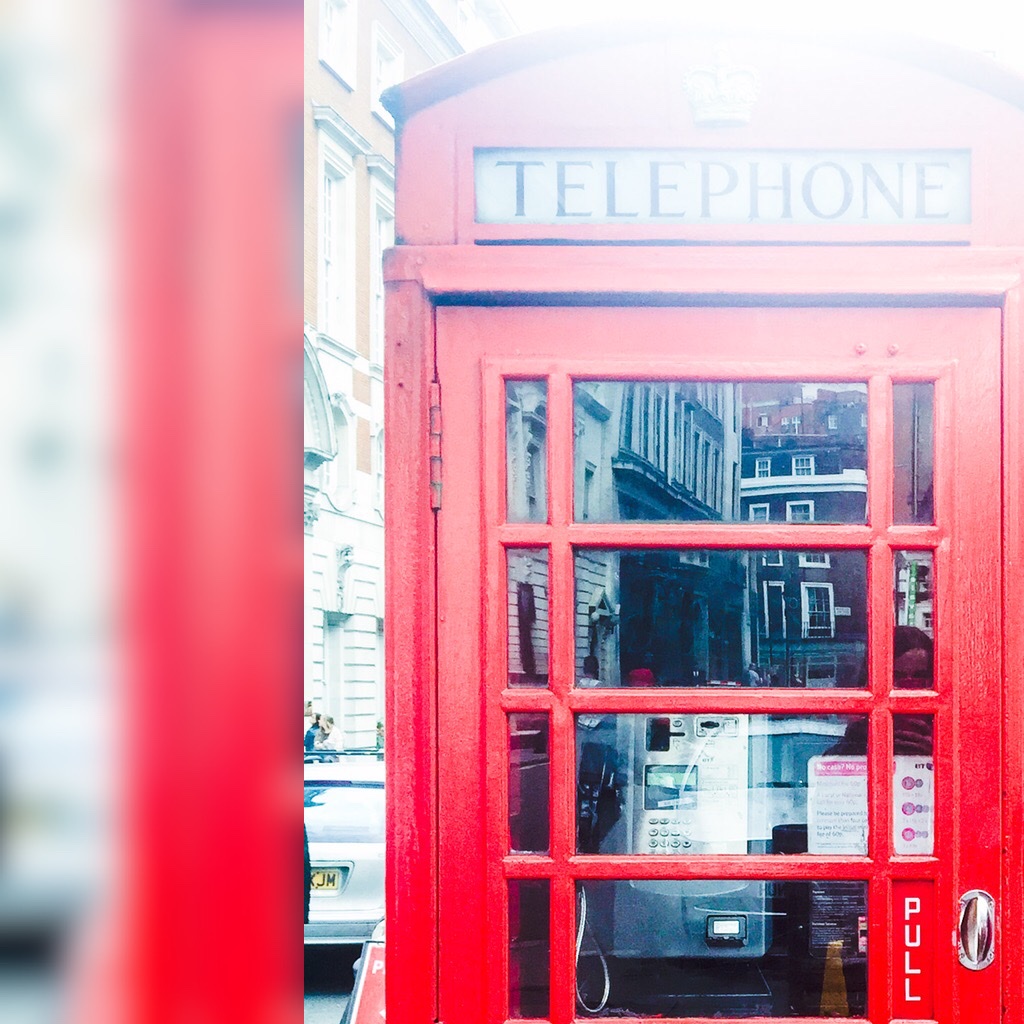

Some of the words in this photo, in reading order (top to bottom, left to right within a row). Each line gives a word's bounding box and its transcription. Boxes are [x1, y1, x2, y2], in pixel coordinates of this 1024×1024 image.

[494, 160, 953, 220] TELEPHONE
[816, 763, 826, 771] No
[827, 763, 845, 771] cash?
[846, 763, 855, 771] No
[904, 897, 921, 1001] PULL
